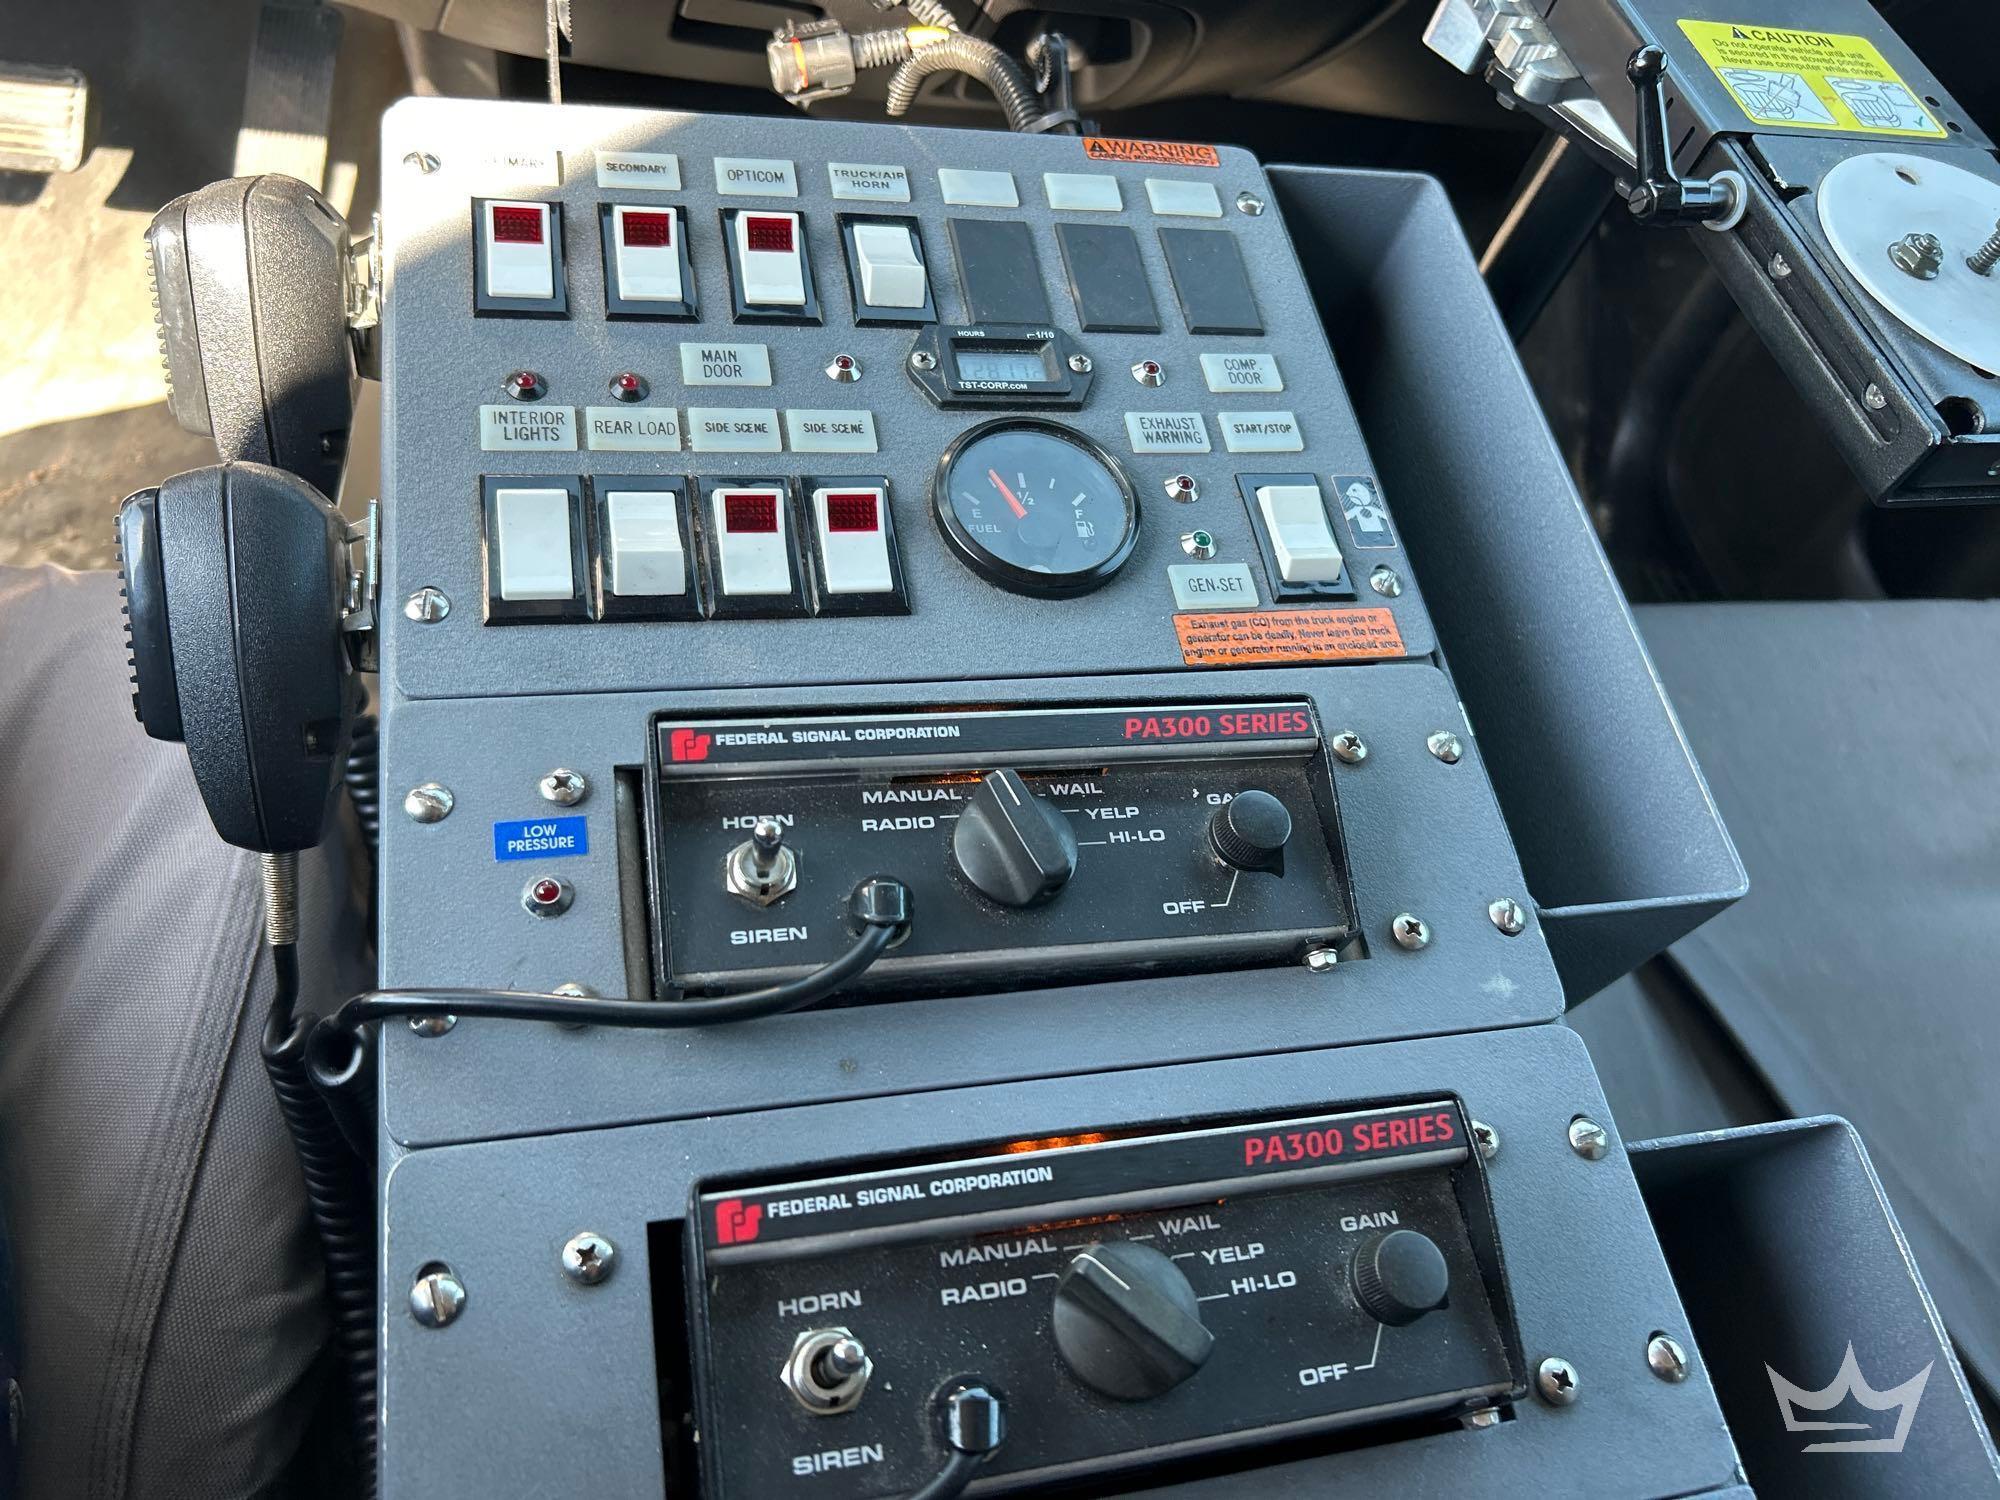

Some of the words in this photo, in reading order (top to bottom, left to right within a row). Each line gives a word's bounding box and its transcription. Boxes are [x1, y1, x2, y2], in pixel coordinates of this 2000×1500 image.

[1751, 30, 1835, 48] CAUTION
[1712, 38, 1729, 47] Do
[1749, 43, 1787, 53] operate
[1788, 46, 1823, 56] vehicle
[1824, 50, 1845, 58] until
[1846, 53, 1866, 61] unit
[1728, 48, 1769, 59] secured
[1780, 53, 1798, 61] the
[1721, 55, 1752, 65] Never
[1776, 61, 1821, 71] computer
[1823, 64, 1850, 74] while
[1106, 141, 1211, 159] WARNING
[606, 162, 667, 175] SECONDARY
[727, 168, 785, 184] OPTICOM
[833, 168, 905, 182] TRUCK/AIR
[851, 178, 890, 190] HORN
[701, 350, 738, 363] MAIN
[1224, 358, 1263, 371] COMP.
[703, 364, 742, 378] DOOR
[1228, 371, 1263, 384] DOOR
[493, 410, 566, 425] INTERIOR
[1140, 417, 1196, 430] EXHAUST
[503, 426, 560, 442] LIGHTS
[594, 420, 632, 434] REAR
[638, 421, 676, 436] LOAD
[704, 422, 731, 433] SIDE
[734, 422, 769, 433] SCENE
[803, 423, 828, 434] SIDE
[831, 423, 864, 434] SCENE
[1233, 423, 1292, 435] START/STOP
[1142, 431, 1203, 444] WARNING
[972, 509, 982, 519] E
[1075, 510, 1083, 519] F
[968, 524, 1001, 533] FUEL
[1191, 619, 1228, 629] Exhaust
[1231, 621, 1247, 629] gas
[1249, 617, 1270, 628] (CO)
[1272, 617, 1293, 626] from
[1295, 616, 1309, 625] the
[1311, 615, 1333, 624] truck
[1336, 614, 1365, 625] engine
[1367, 614, 1377, 622] or
[1186, 632, 1230, 644] generator
[1251, 631, 1262, 640] be
[1299, 629, 1324, 638] Never
[1326, 628, 1350, 638] leave
[1352, 627, 1366, 636] the
[1368, 626, 1390, 635] truck
[1184, 648, 1215, 658] engine
[1218, 647, 1228, 655] or
[1230, 645, 1273, 656] generator
[1276, 642, 1311, 653] running
[1313, 642, 1323, 651] in
[1338, 640, 1377, 650] enclosed
[1124, 716, 1210, 739] PA300
[1219, 711, 1310, 735] SERIES
[716, 732, 788, 746] FEDERAL
[793, 729, 851, 744] SIGNAL
[855, 725, 960, 741] CORPORATION
[862, 788, 962, 805] MANUAL
[1050, 782, 1103, 797] WAIL
[1085, 805, 1140, 820] YELP
[524, 823, 557, 838] LOW
[862, 816, 935, 833] RADIO
[1110, 828, 1166, 843] HI-LO
[508, 836, 575, 853] PRESSURE
[1162, 900, 1205, 916] OFF
[730, 927, 808, 945] SIREN
[1244, 1128, 1343, 1166] PA300
[1352, 1113, 1455, 1152] SERIES
[767, 1194, 852, 1219] FEDERAL
[856, 1187, 926, 1207] SIGNAL
[929, 1166, 1053, 1197] CORPORATION
[1158, 1214, 1221, 1237] WAIL
[1339, 1210, 1400, 1232] GAIN
[939, 1237, 1050, 1268] MANUAL
[1201, 1242, 1265, 1266] YELP
[1231, 1270, 1298, 1295] HI-LO
[940, 1278, 1028, 1306] RADIO
[777, 1289, 862, 1317] HORN
[1298, 1362, 1348, 1387] OFF
[791, 1443, 885, 1476] SIREN
